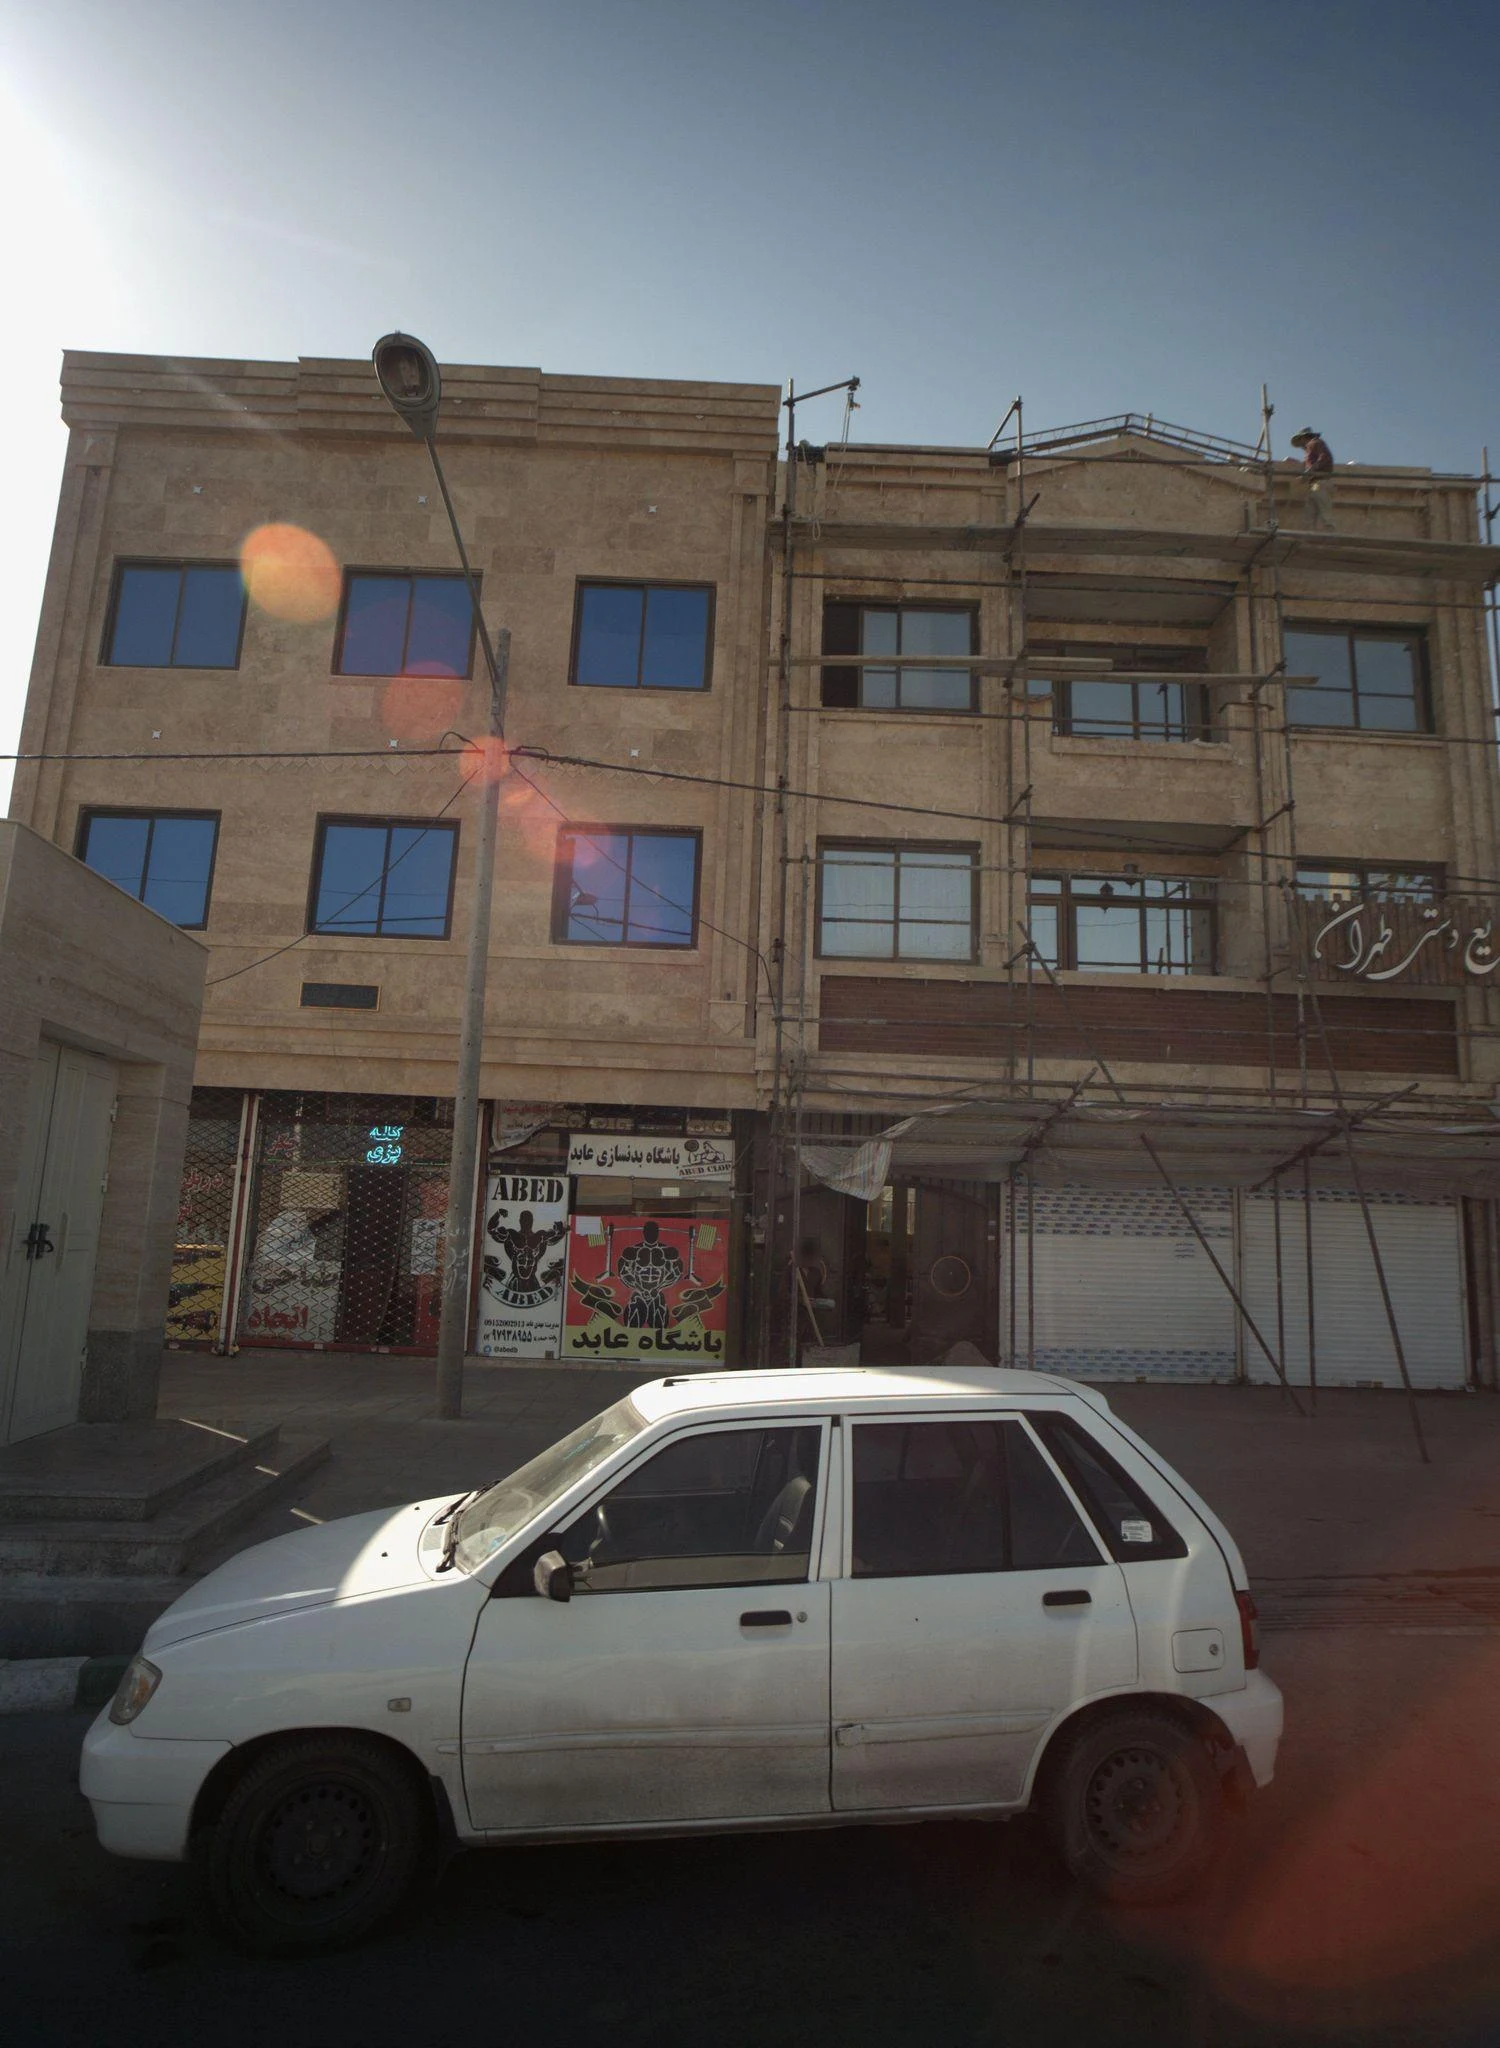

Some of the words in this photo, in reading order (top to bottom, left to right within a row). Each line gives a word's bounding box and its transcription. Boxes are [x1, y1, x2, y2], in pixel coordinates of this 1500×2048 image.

[570, 1143, 594, 1165] عابد
[596, 1144, 643, 1168] بدنسازی
[646, 1145, 680, 1169] باشگاه
[492, 1177, 564, 1203] ABED
[495, 1286, 554, 1305] ABED
[572, 1327, 630, 1355] عابد
[638, 1329, 723, 1359] باشگاه
